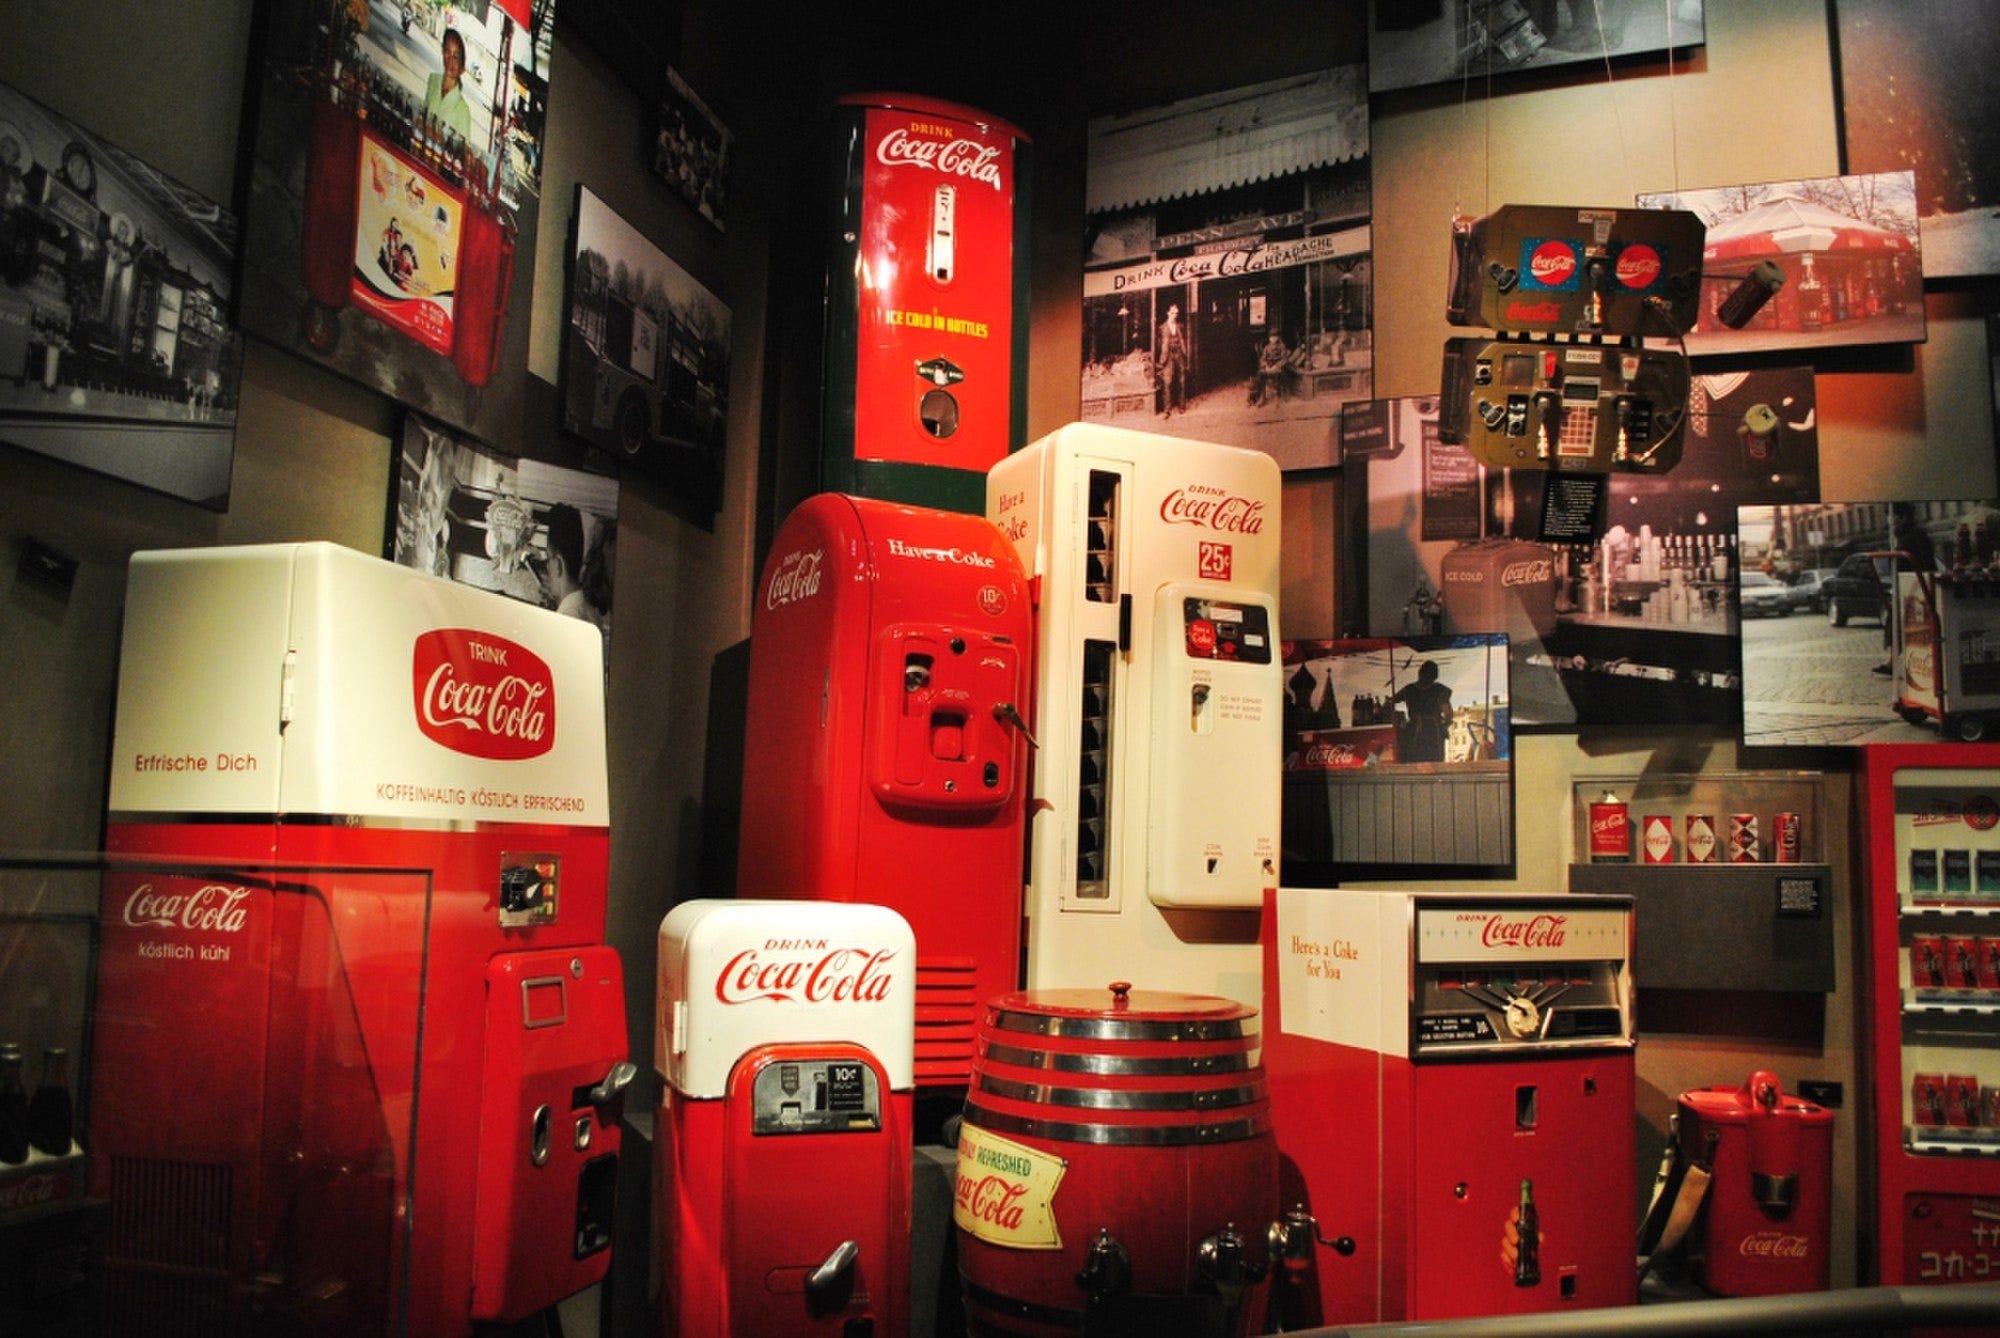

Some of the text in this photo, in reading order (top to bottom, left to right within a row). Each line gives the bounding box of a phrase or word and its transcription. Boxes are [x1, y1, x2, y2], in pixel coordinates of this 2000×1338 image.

[910, 122, 953, 138] DRINK
[877, 128, 1001, 190] Coca-Cola
[1265, 238, 1333, 269] HEADACHE
[1114, 265, 1163, 290] DRINK
[885, 310, 904, 326] ICE
[905, 311, 932, 329] COLD
[947, 317, 988, 339] BOTTLES
[1188, 484, 1227, 497] DRINK
[1160, 488, 1265, 536] Coca-Cola
[887, 538, 932, 560] Have
[946, 547, 996, 569] Coke
[1200, 543, 1230, 573] 25¢
[766, 549, 823, 610] Coca-Cola
[1501, 560, 1552, 587] Coca-Cola
[468, 641, 508, 668] TRINK
[423, 662, 548, 742] Coca-Cola
[134, 754, 258, 772] Erfrische Dich
[376, 783, 466, 806] KOFFEINHALTIG
[523, 794, 586, 813] ERFRISCHEND
[123, 884, 251, 932] Coca-Cola
[764, 938, 828, 951] DRINK
[1482, 914, 1567, 948] Coca-Cola
[139, 941, 231, 961] köstlich kühl
[1292, 935, 1359, 960] Here's a Coke
[715, 948, 899, 1005] Coca-Cola
[1307, 957, 1342, 981] for You
[835, 1067, 857, 1081] 10¢
[977, 1145, 1032, 1177] REFRESHED
[1739, 1233, 1809, 1257] Coca-Cola
